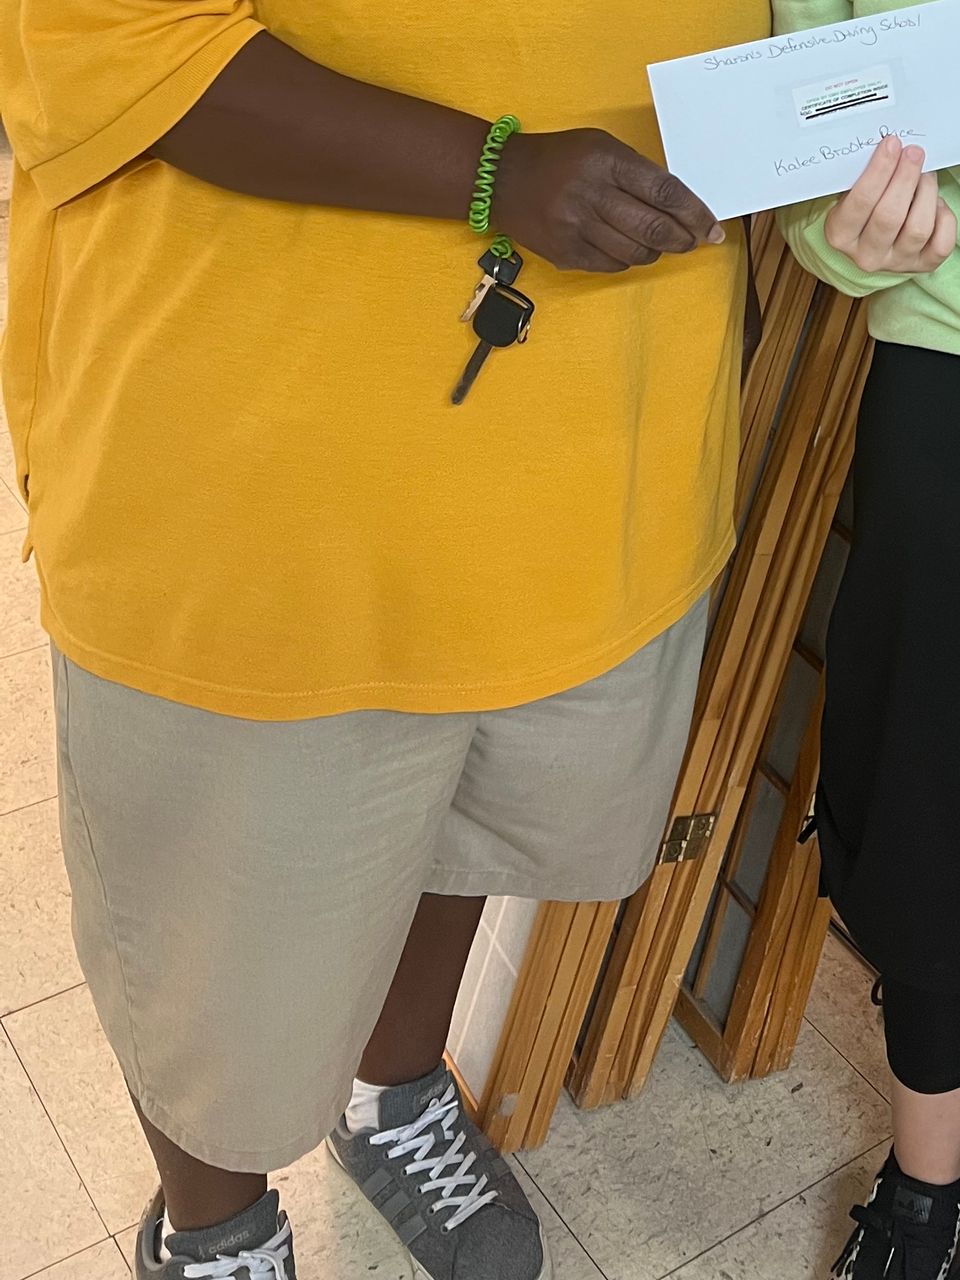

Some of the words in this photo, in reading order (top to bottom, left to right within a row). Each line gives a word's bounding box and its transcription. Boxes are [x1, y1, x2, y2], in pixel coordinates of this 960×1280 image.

[703, 50, 763, 71] Sharon's
[767, 35, 833, 59] Defensive
[833, 24, 878, 46] Driving
[879, 14, 921, 32] School
[774, 155, 821, 177] Kalee
[208, 1230, 250, 1254] adidas
